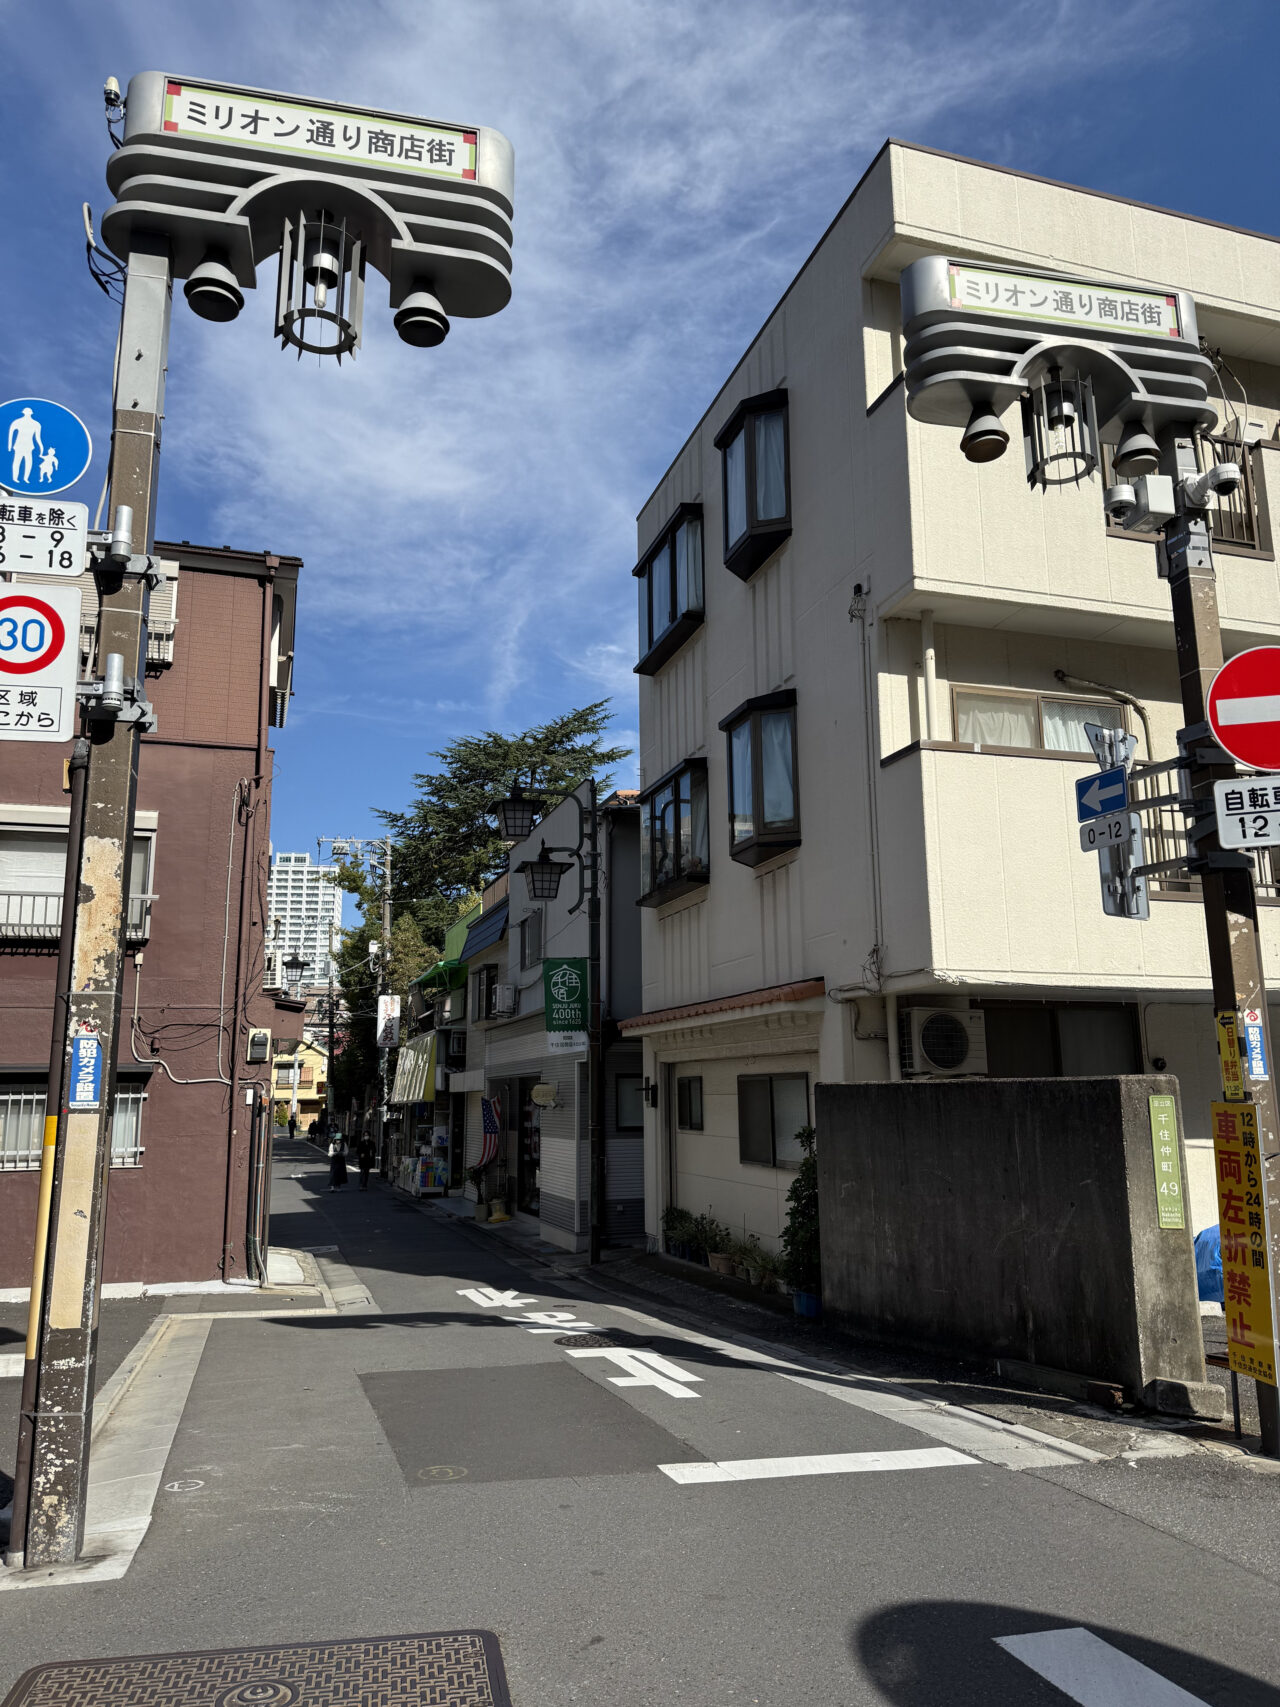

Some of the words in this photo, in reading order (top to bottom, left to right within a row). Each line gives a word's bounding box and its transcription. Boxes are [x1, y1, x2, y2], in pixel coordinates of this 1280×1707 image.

[187, 101, 455, 166] ミリオン通り商店街
[966, 279, 1162, 327] ミリオン通り商店街
[48, 550, 73, 568] 18
[0, 617, 45, 652] 30
[0, 690, 38, 707] 区域
[1088, 821, 1122, 844] 0-12
[552, 1009, 581, 1018] 400th
[1158, 1113, 1172, 1172] 千住仲町
[1160, 1182, 1179, 1196] 49
[1240, 1112, 1264, 1269] 12時から24時の間
[1216, 1110, 1255, 1349] 車両左折禁止
